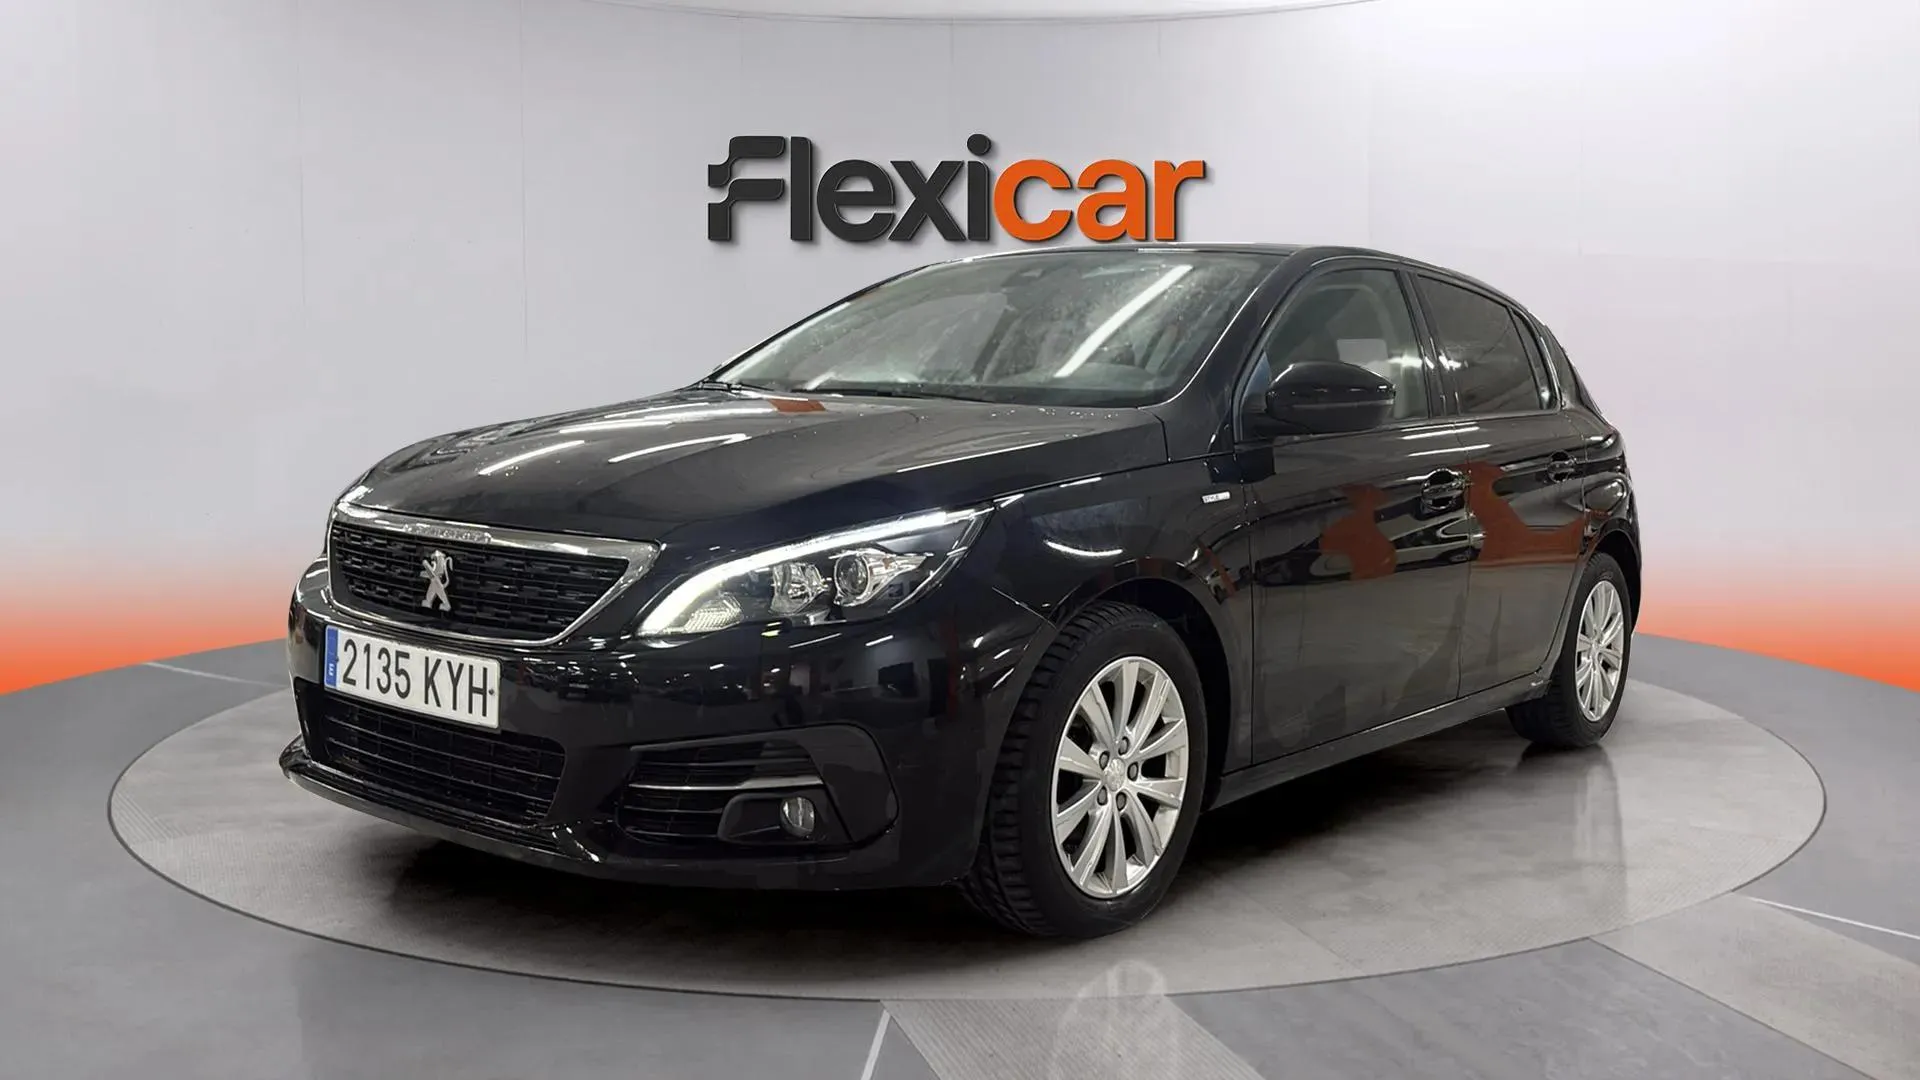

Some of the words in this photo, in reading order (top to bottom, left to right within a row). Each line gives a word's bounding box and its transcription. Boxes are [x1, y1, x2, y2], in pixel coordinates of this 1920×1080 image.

[708, 133, 1206, 242] Flexicar
[342, 638, 411, 699] 2135
[424, 656, 488, 717] KYH
